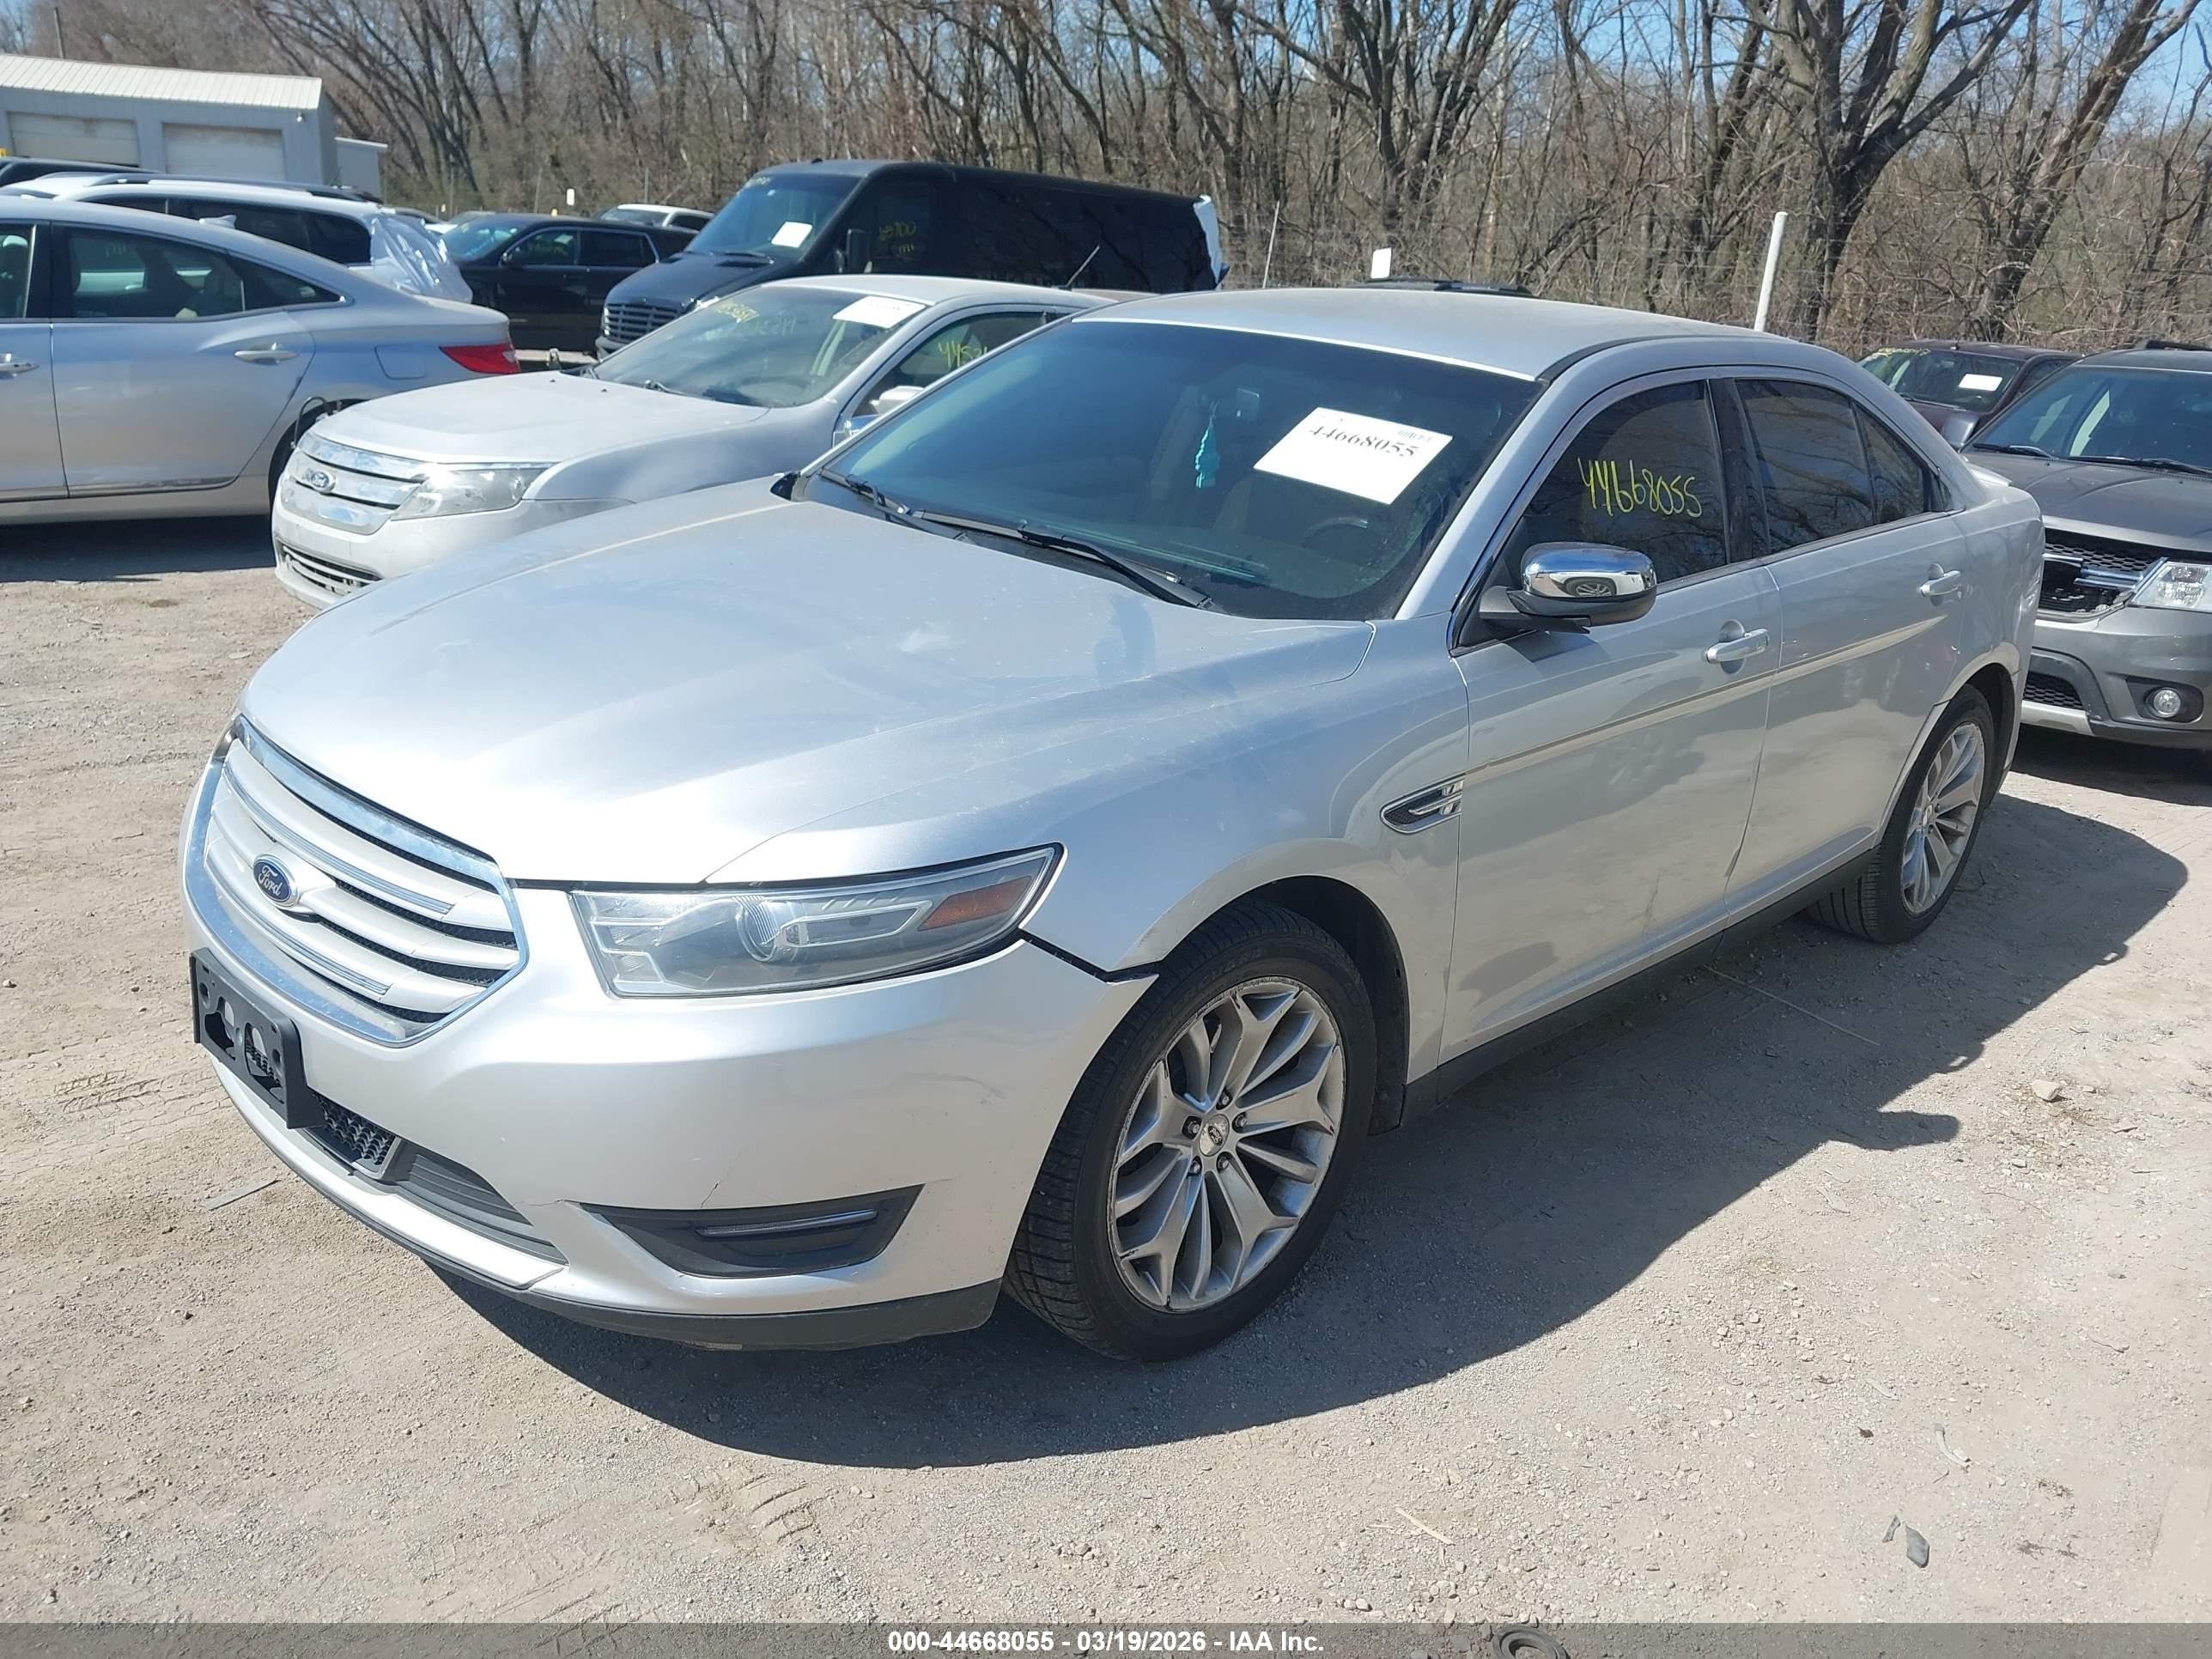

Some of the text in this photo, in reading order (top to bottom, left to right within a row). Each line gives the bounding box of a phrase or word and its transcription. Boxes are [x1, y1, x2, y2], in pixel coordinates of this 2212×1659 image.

[1309, 426, 1419, 457] 44668055
[1577, 456, 1703, 518] 44668055
[258, 864, 285, 896] Ford
